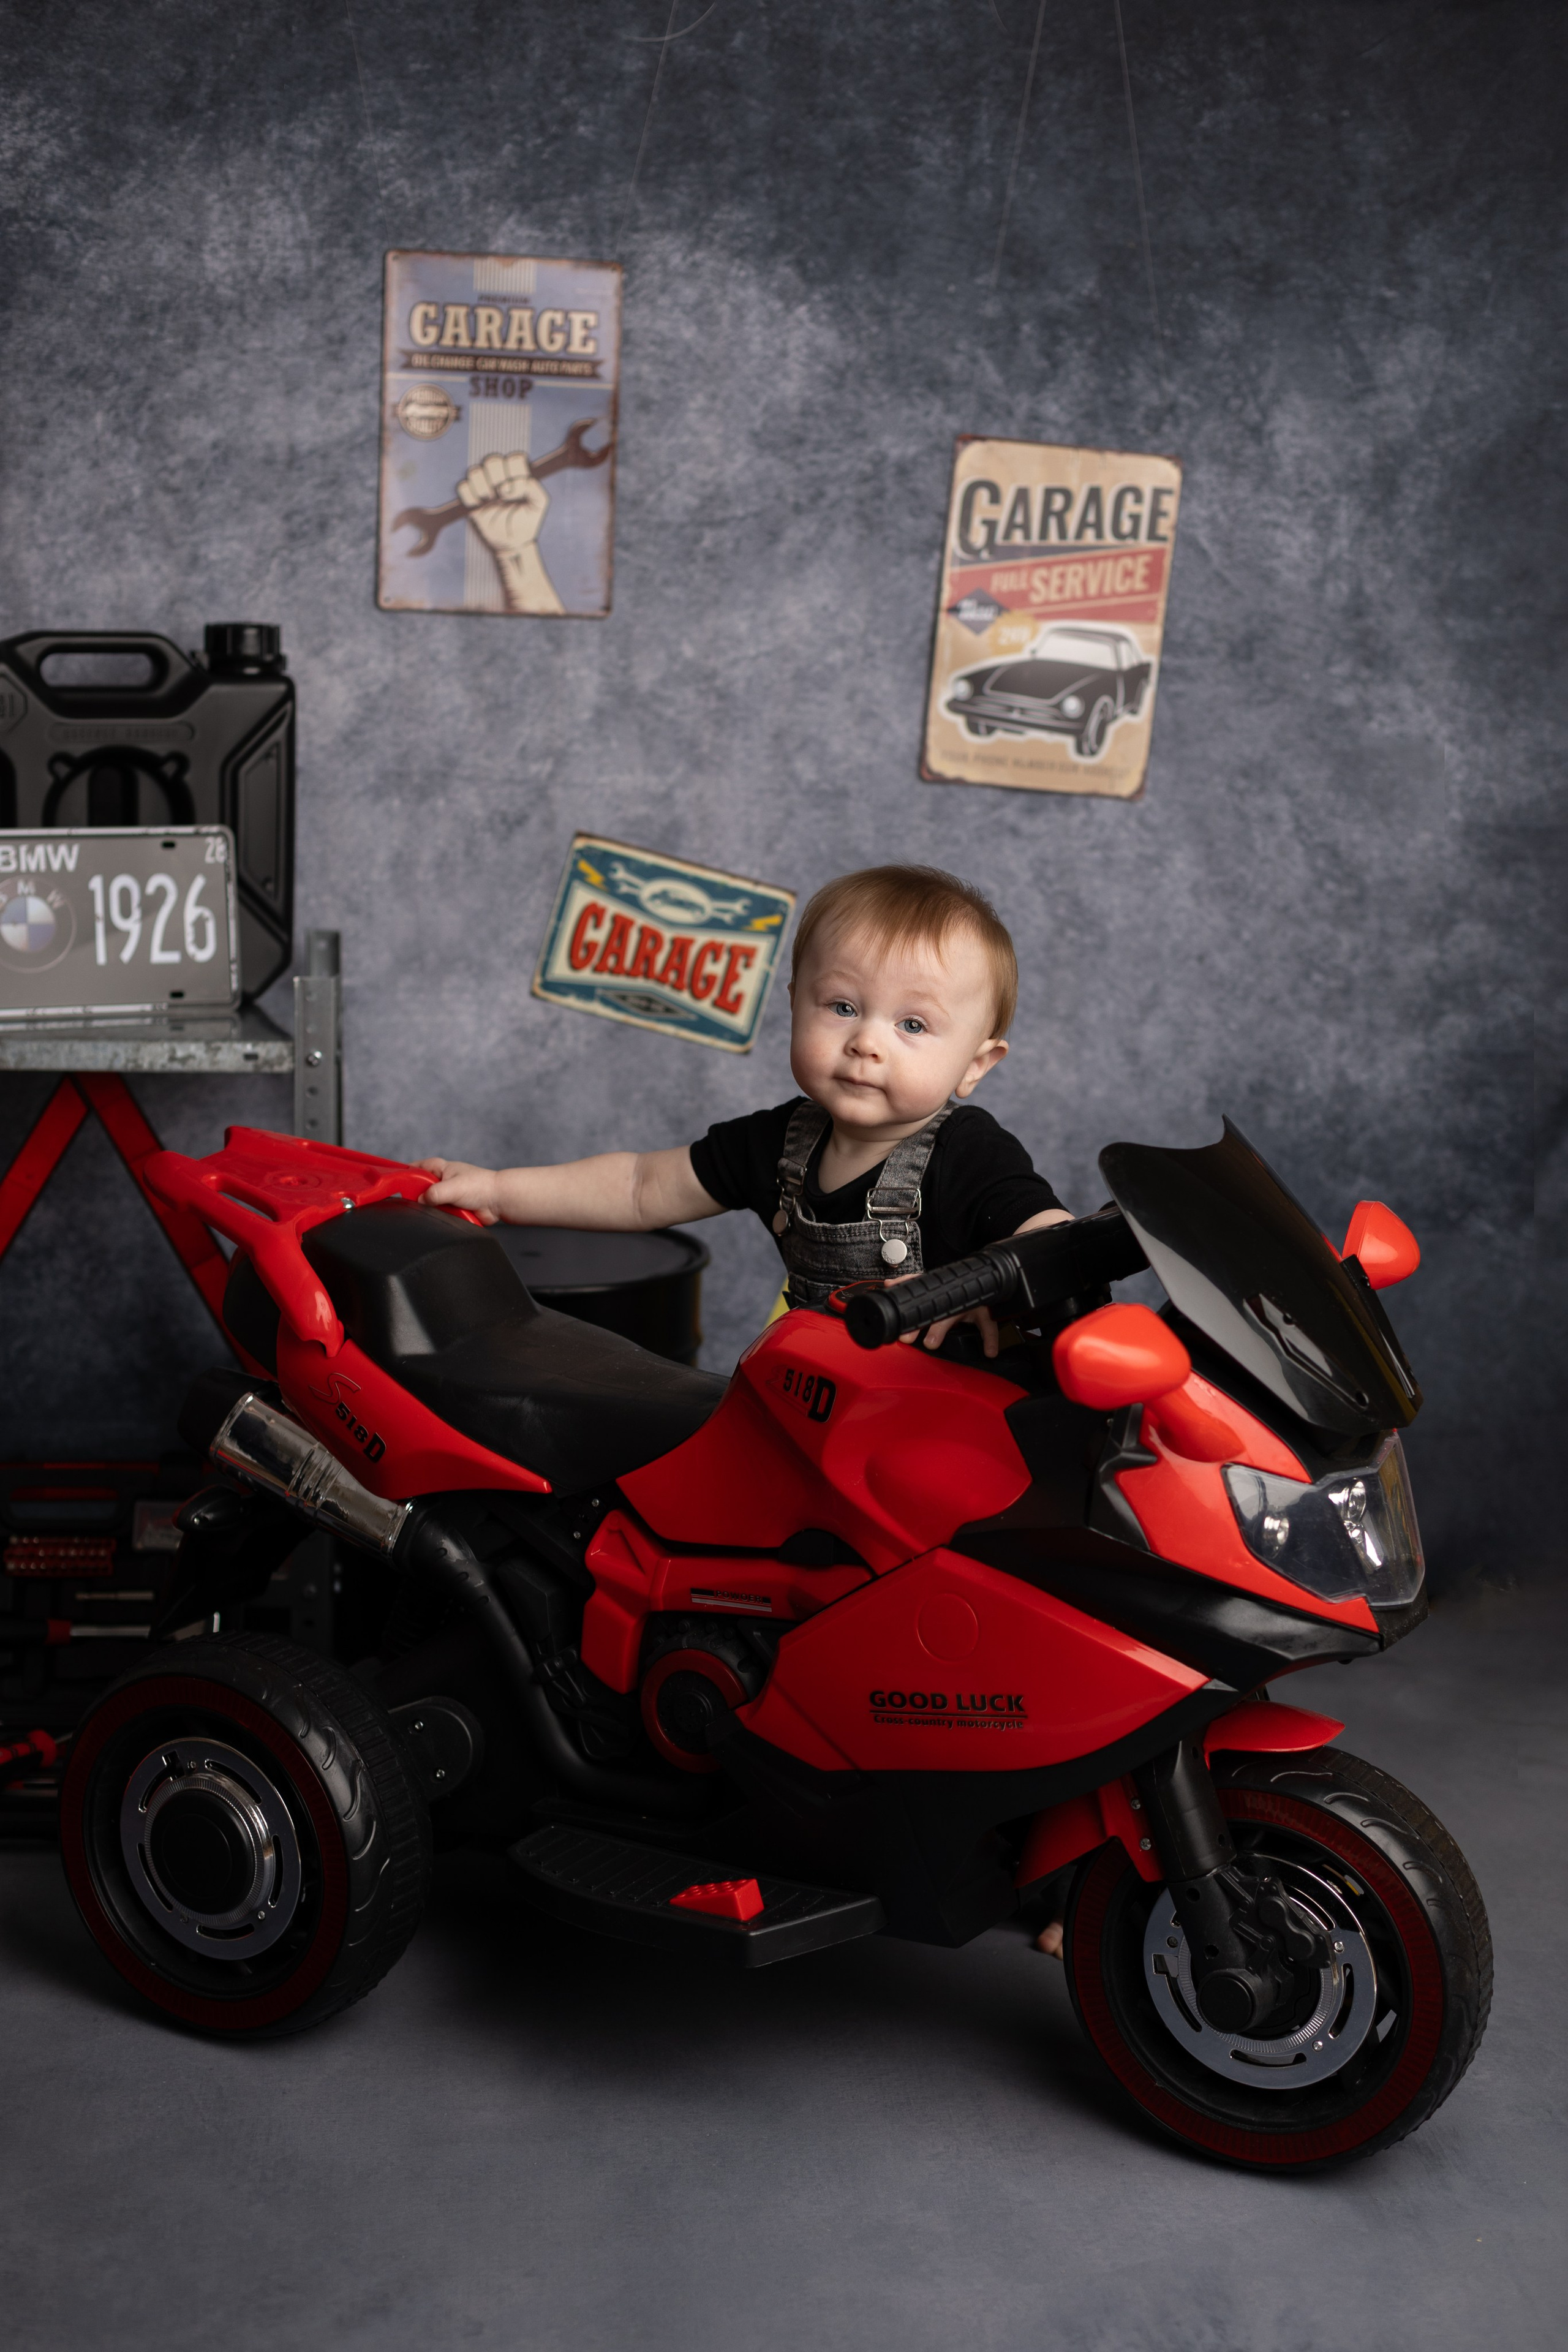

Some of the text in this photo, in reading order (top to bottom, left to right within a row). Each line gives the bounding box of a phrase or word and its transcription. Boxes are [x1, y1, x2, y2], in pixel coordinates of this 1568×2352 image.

[409, 301, 598, 355] GARAGE
[412, 353, 593, 376] OIL CHANGE CAR WASH AUTO PARTS
[469, 375, 533, 400] SHOP
[957, 480, 1174, 556] GARAGE
[990, 554, 1153, 605] FULL SERVICE
[0, 843, 80, 873] BMW
[88, 872, 217, 966] 1926
[569, 901, 759, 1015] GARAGE
[783, 1368, 837, 1424] 518D
[336, 1401, 387, 1464] 518D
[869, 1690, 1026, 1713] GOOD LUCK
[873, 1716, 1024, 1732] Cross-country motorcycle
